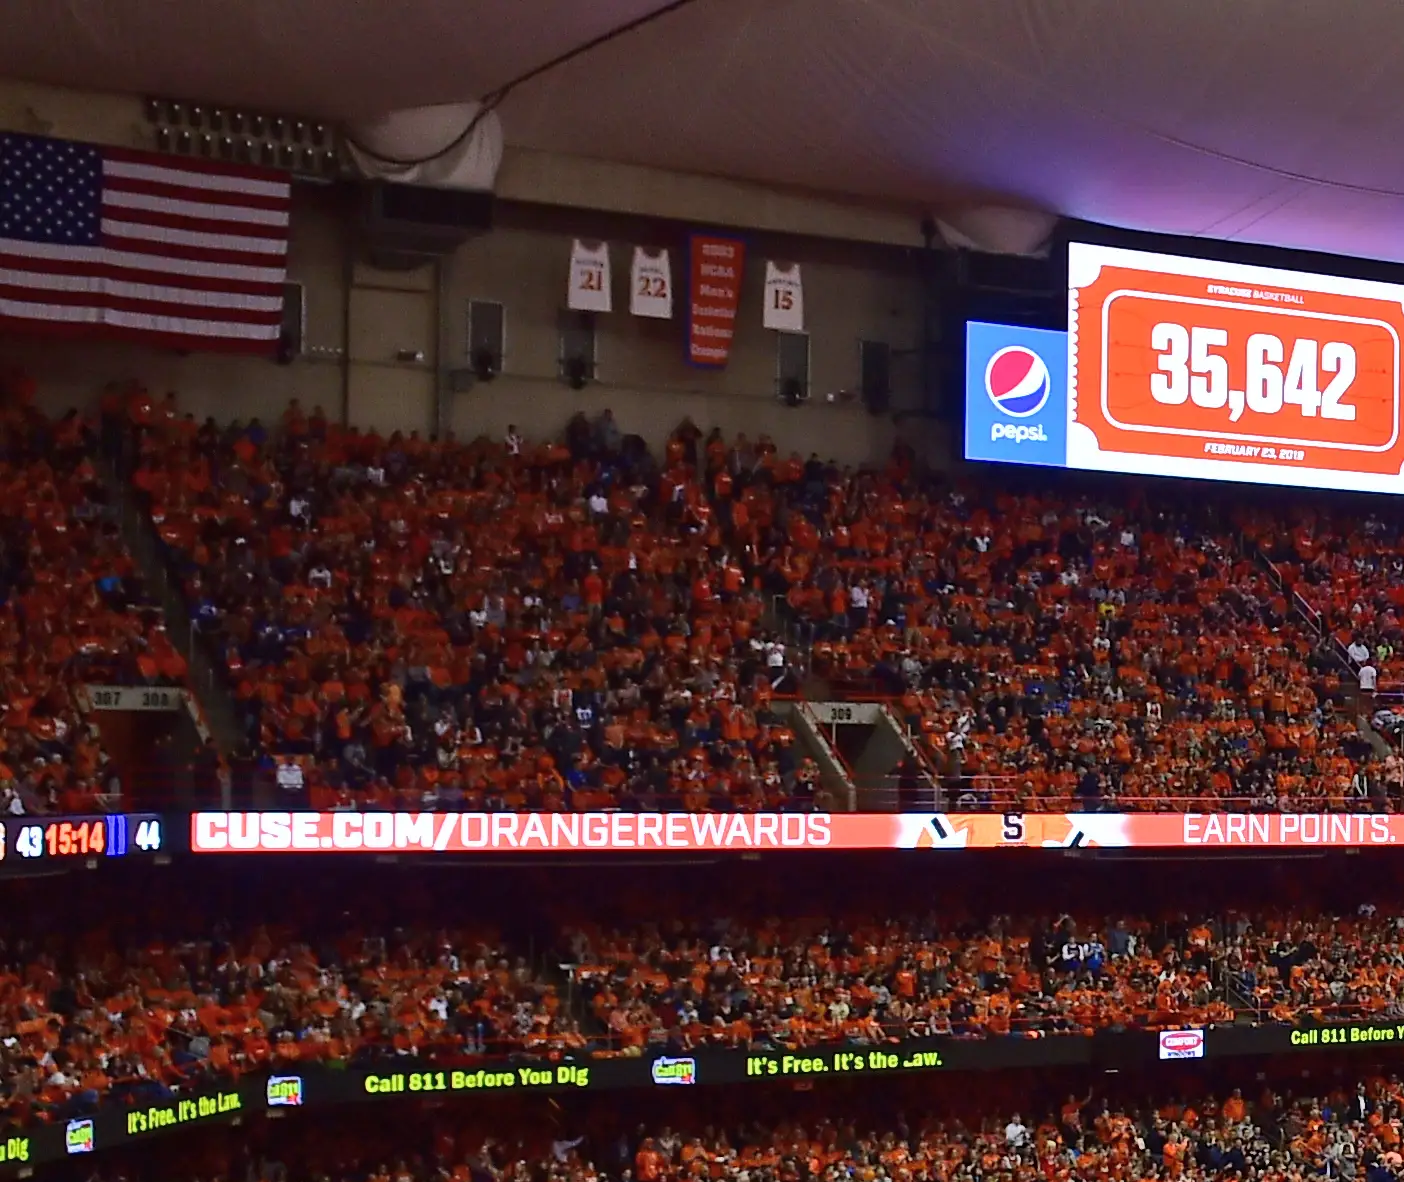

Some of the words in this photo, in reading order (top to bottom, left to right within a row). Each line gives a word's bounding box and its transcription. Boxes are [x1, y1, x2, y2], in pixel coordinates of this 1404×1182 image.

[579, 269, 603, 291] 21
[638, 277, 666, 298] 22
[774, 289, 794, 310] 15
[1253, 289, 1304, 304] BASKETBALL
[1150, 322, 1356, 423] 35,642
[1204, 442, 1259, 458] FEBRUARY
[95, 692, 121, 705] 307
[46, 820, 104, 855] 15:14
[135, 821, 161, 850] 44
[199, 812, 831, 851] CUSE.COM/ORANGEREWARDS
[1184, 814, 1268, 843] EARN
[1279, 814, 1396, 843] POINTS.
[16, 825, 42, 858] 43
[1290, 1030, 1316, 1045] Call
[1321, 1028, 1347, 1043] 811
[1351, 1027, 1393, 1042] Before
[747, 1055, 778, 1075] It's
[782, 1054, 829, 1074] Free.
[834, 1052, 865, 1072] It's
[868, 1051, 898, 1070] the
[365, 1075, 404, 1093] Call
[408, 1072, 447, 1091] 811
[451, 1070, 515, 1089] Before
[518, 1068, 552, 1085] You
[556, 1066, 589, 1087] Dig
[127, 1110, 147, 1134] It's
[148, 1105, 177, 1130] Free.
[178, 1099, 198, 1121] It's
[199, 1096, 216, 1117] the
[218, 1091, 241, 1113] Law.
[7, 1137, 29, 1162] Dig
